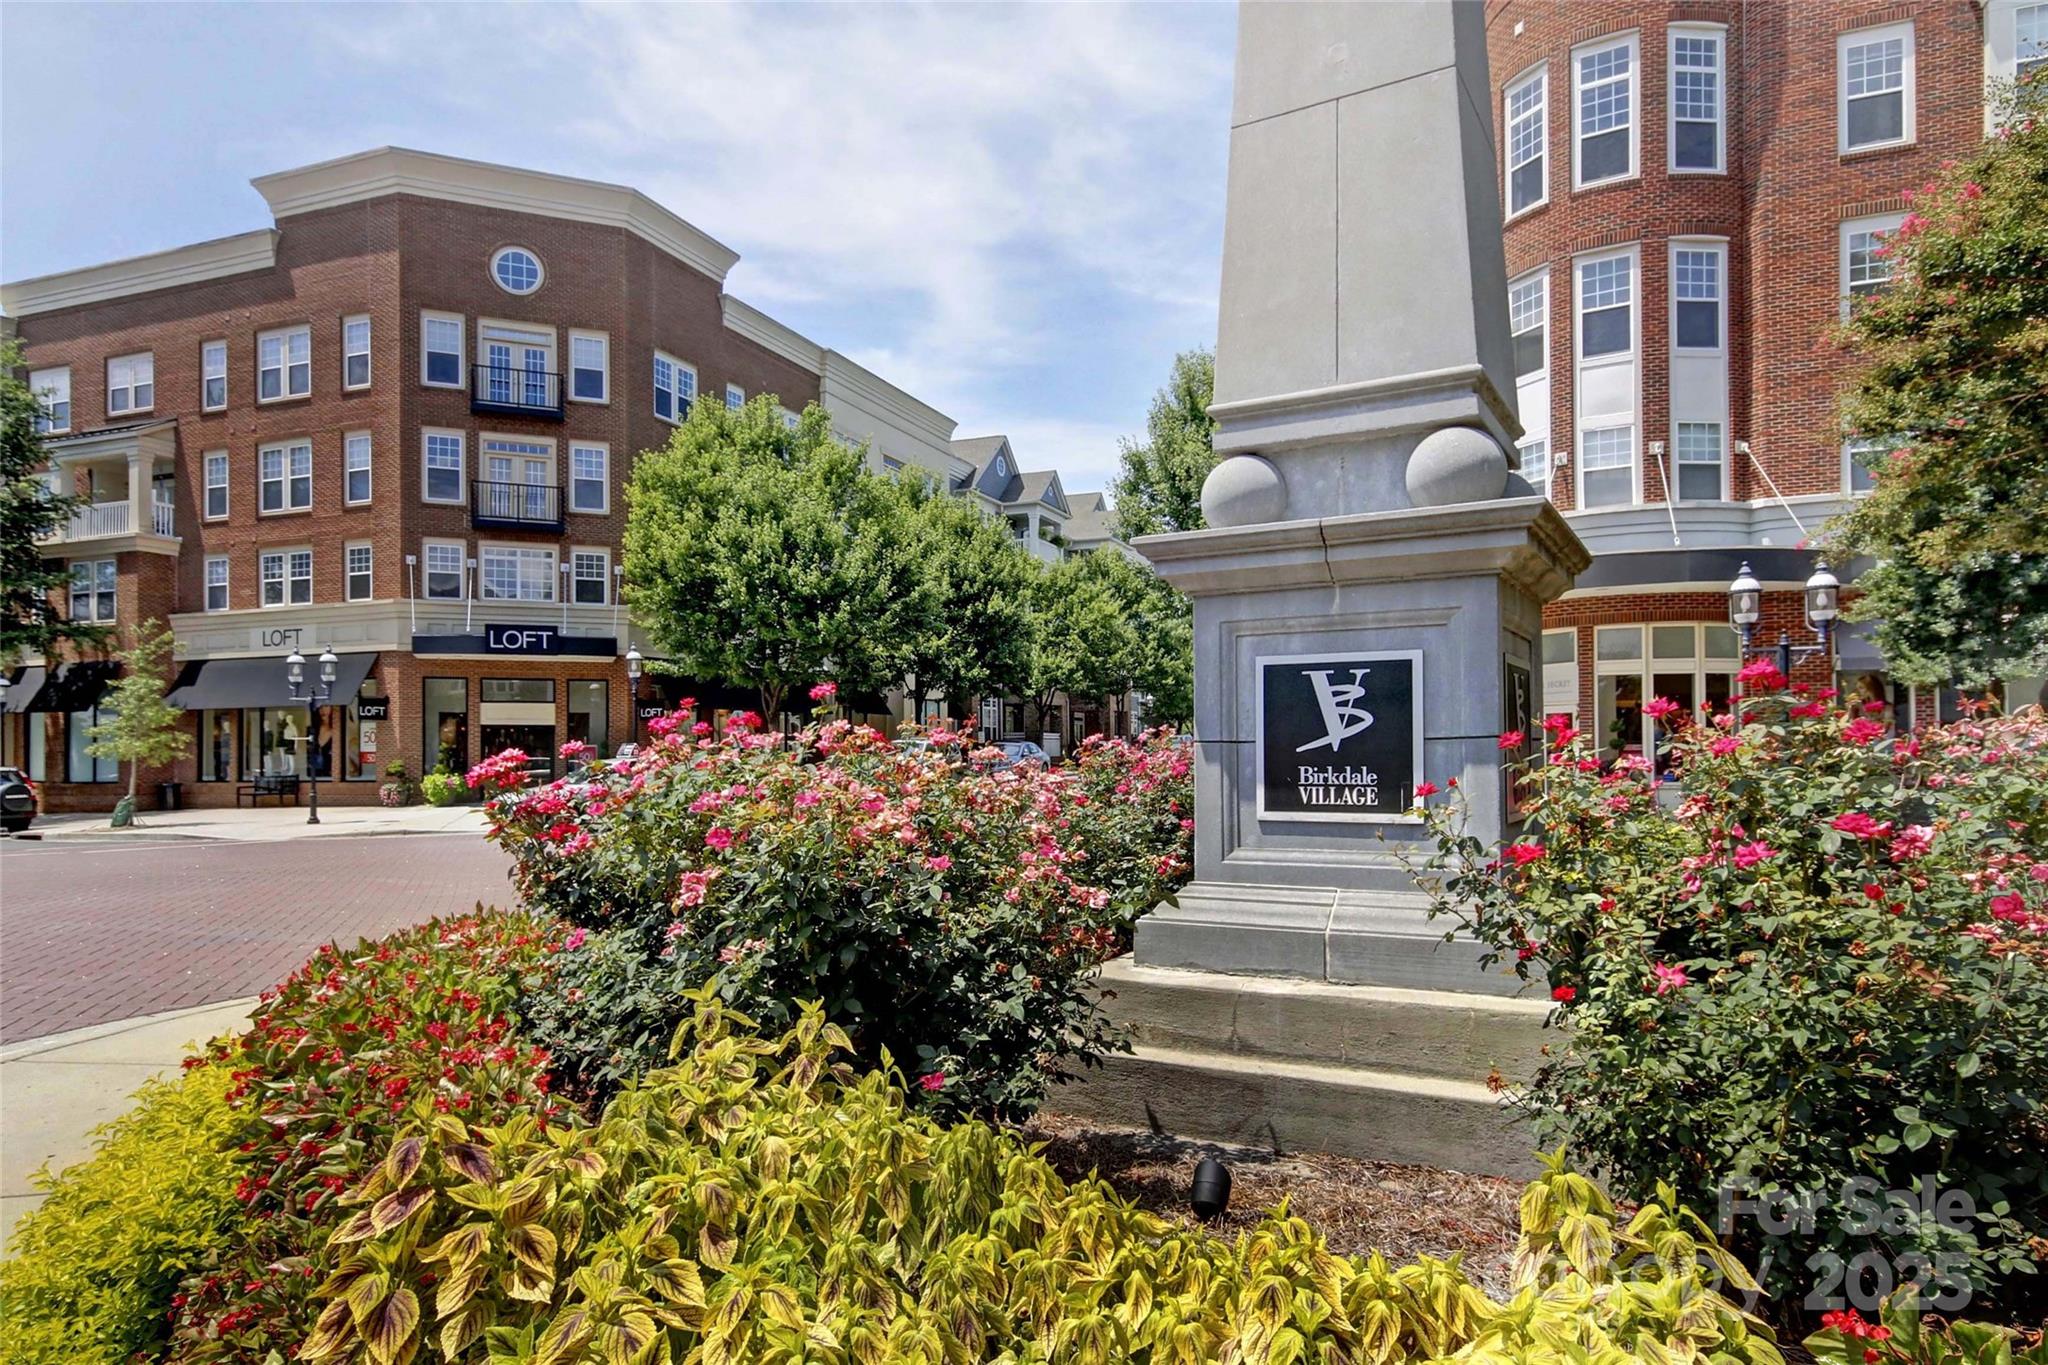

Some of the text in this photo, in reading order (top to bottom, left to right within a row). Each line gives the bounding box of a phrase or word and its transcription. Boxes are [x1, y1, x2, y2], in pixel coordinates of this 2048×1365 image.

[262, 628, 303, 647] LOFT
[490, 630, 553, 649] LOFT
[360, 706, 386, 716] LOFT
[640, 708, 662, 718] LOFT
[1298, 766, 1378, 785] Birkdale
[1299, 786, 1379, 806] VILLAGE
